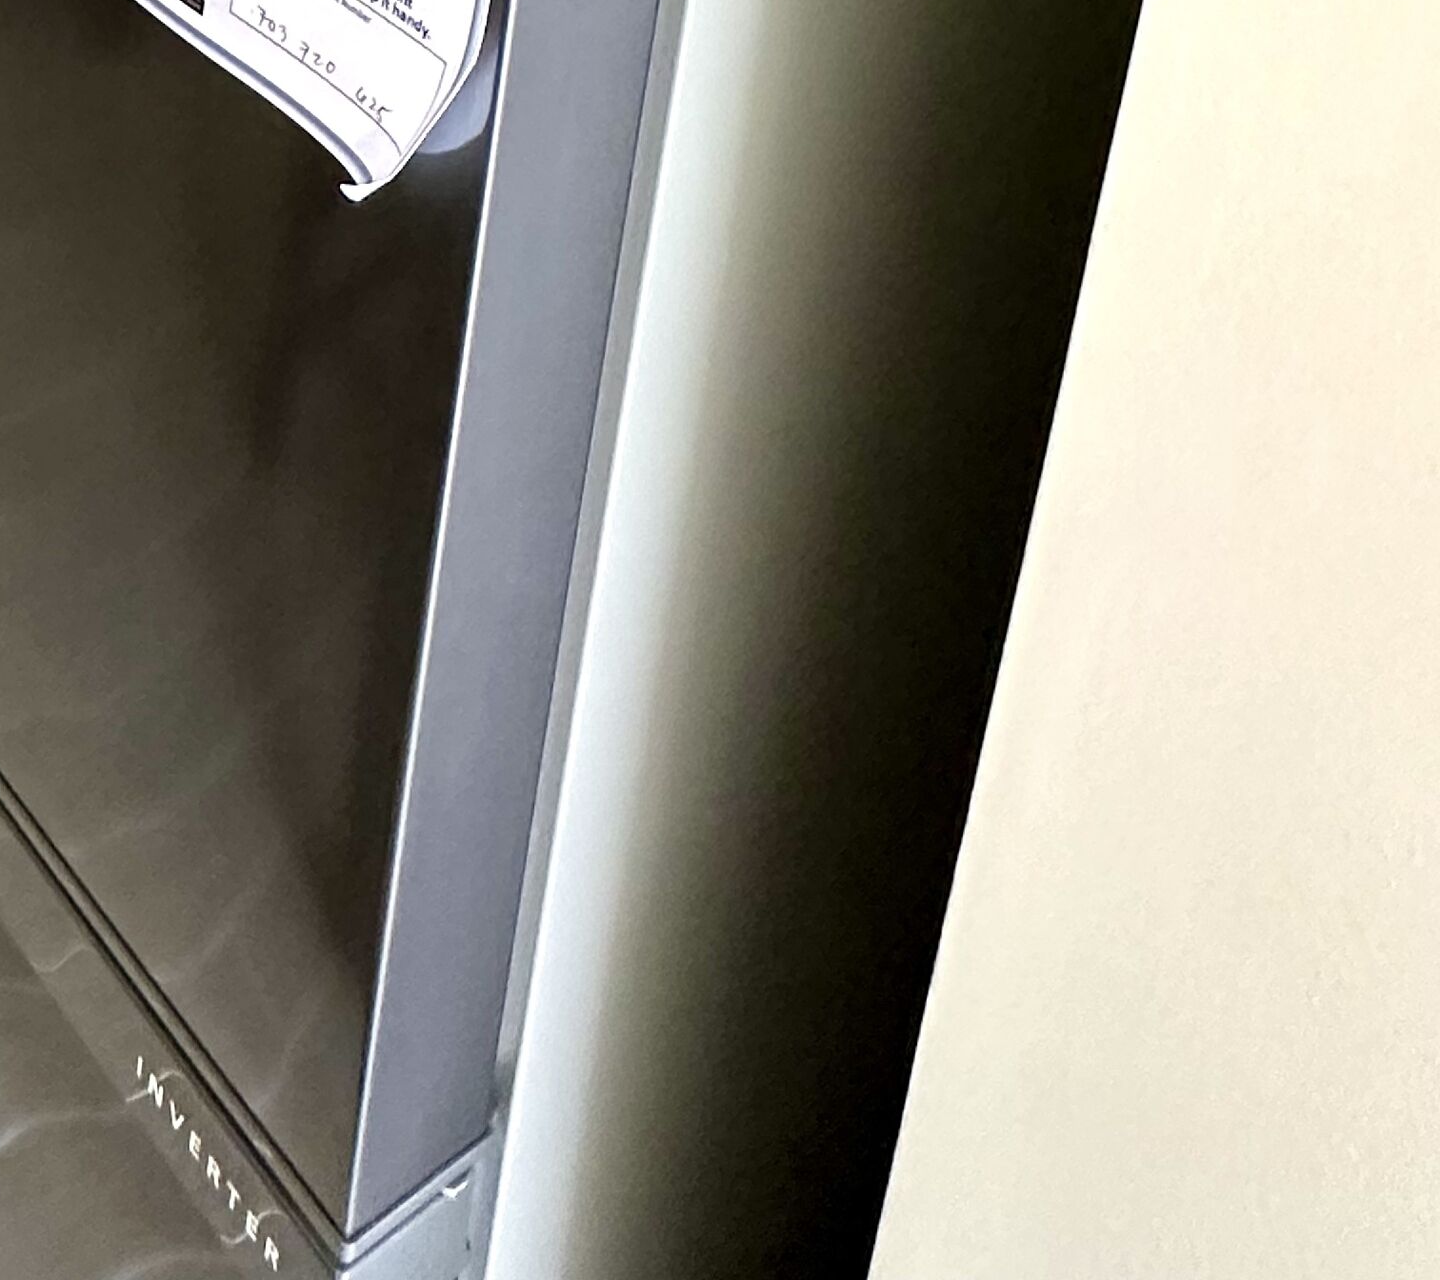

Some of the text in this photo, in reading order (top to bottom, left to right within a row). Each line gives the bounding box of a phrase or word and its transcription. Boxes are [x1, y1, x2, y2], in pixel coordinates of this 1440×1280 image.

[257, 4, 288, 42] 703
[299, 40, 336, 75] 720
[392, 1, 431, 40] handy.
[136, 1055, 280, 1273] INVERTER
